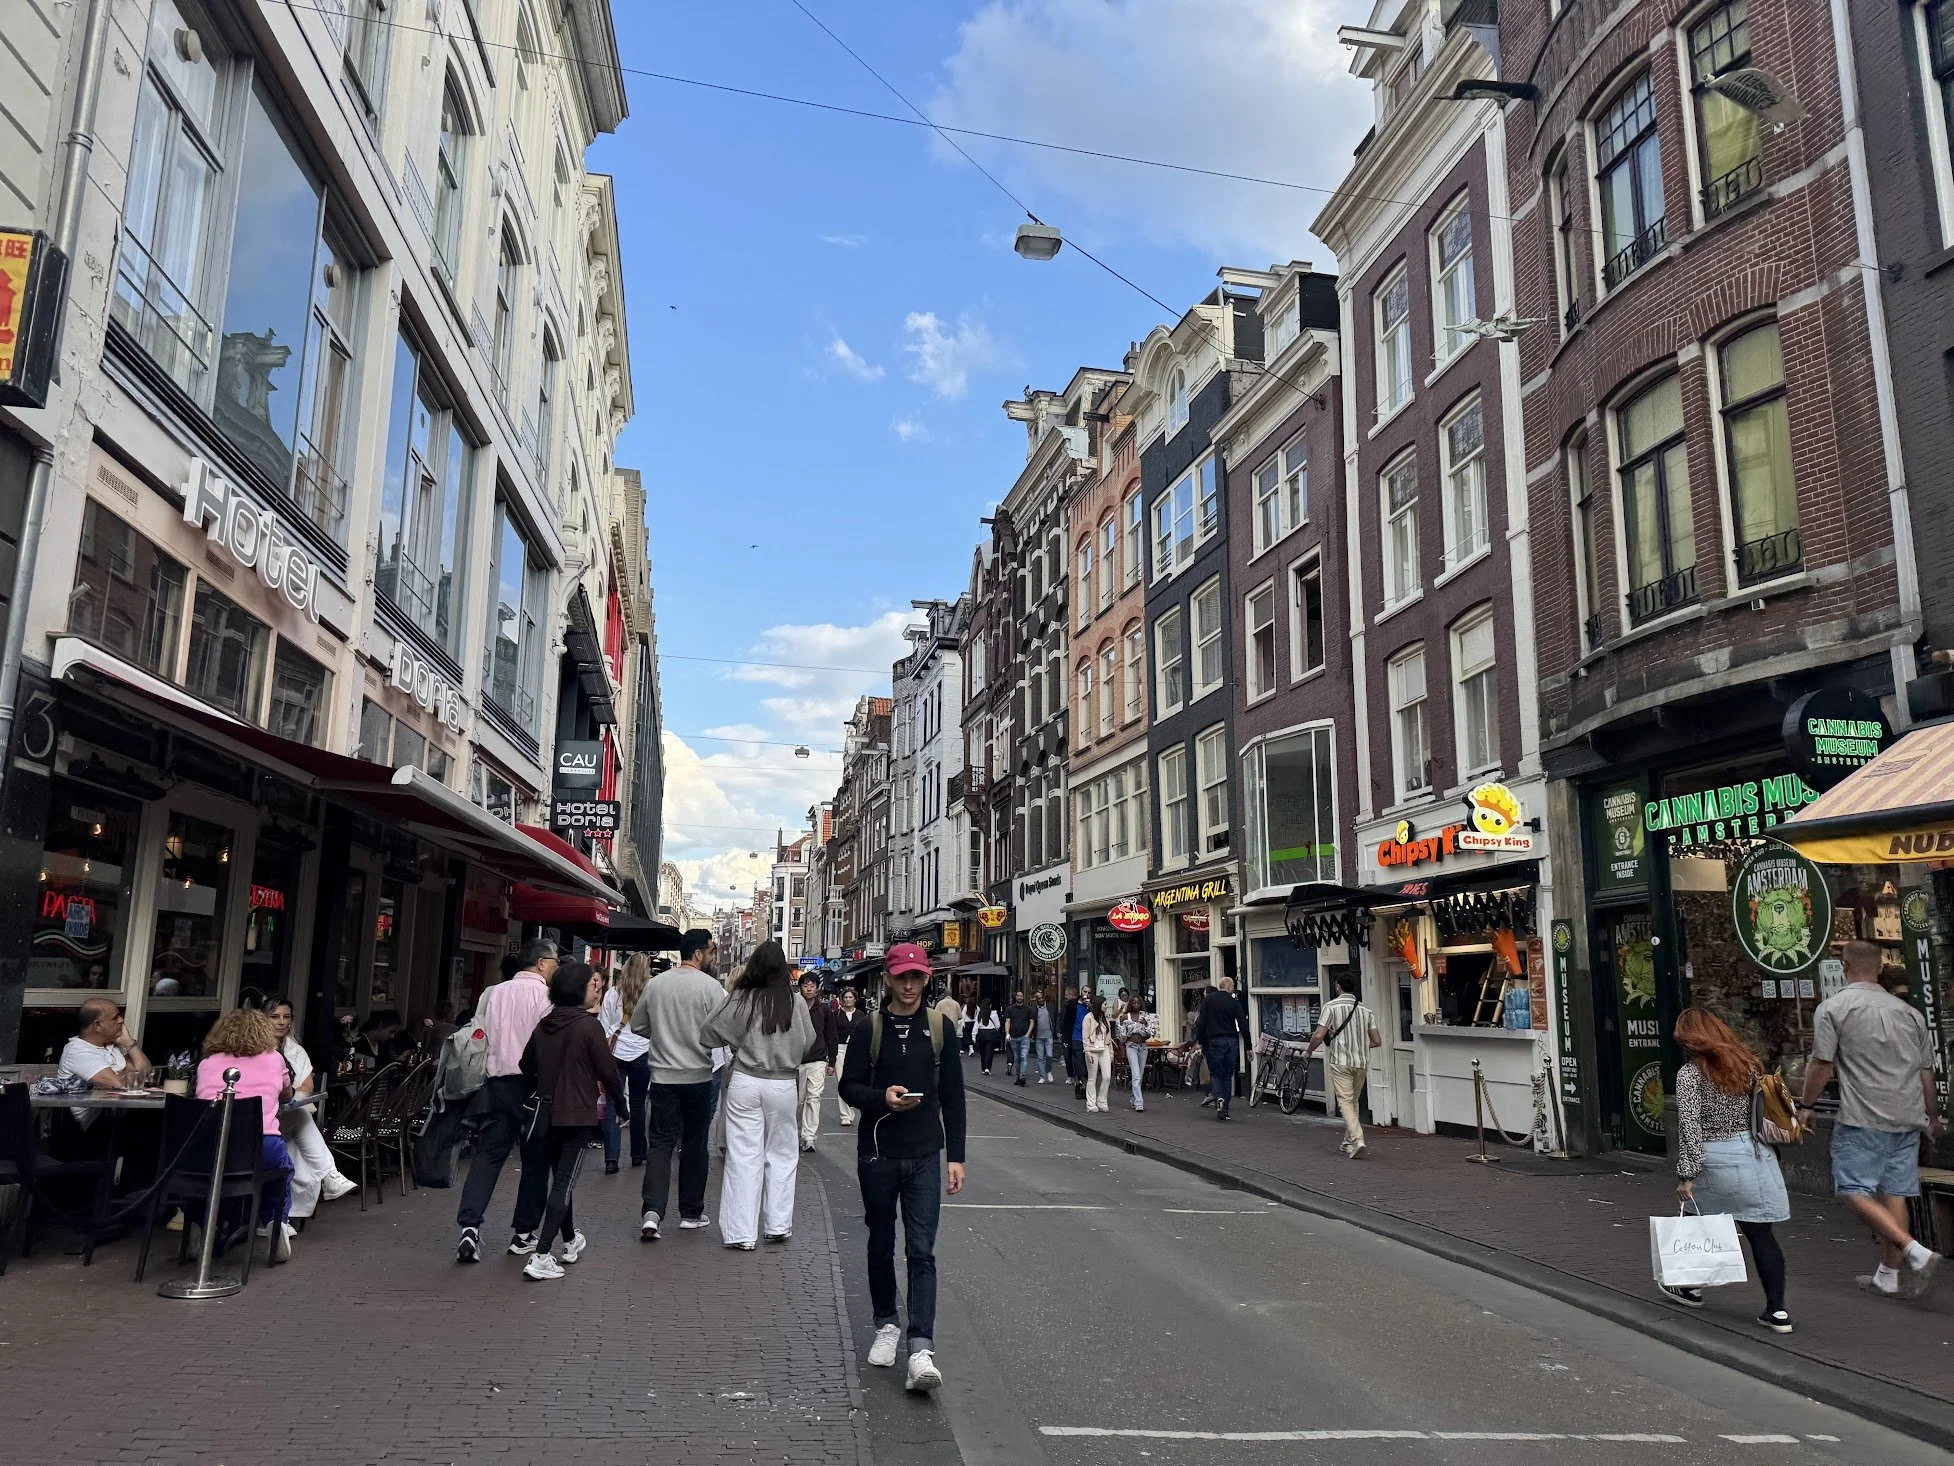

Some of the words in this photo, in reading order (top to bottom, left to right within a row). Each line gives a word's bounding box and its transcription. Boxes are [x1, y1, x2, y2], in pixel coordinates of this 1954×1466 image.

[183, 456, 321, 625] Hotel
[391, 641, 461, 734] Doria
[22, 690, 57, 759] 3
[1807, 718, 1883, 738] CANNABIS
[1815, 737, 1879, 757] MUSEUM
[560, 753, 597, 768] CAU
[1603, 792, 1636, 809] CANNABIS
[1644, 782, 1760, 832] CANNABIS
[1606, 803, 1636, 819] MUSEUM
[1462, 835, 1503, 848] Chipsy
[1504, 837, 1530, 848] King
[1378, 837, 1438, 868] Chipsy
[1611, 860, 1639, 872] ENTRANCE
[1616, 869, 1635, 879] INSIDE
[1747, 867, 1809, 897] AMSTERDAM
[1154, 884, 1200, 909] ARGENTINA
[1201, 879, 1227, 902] GRILL
[1560, 957, 1572, 1052] MUSEUM
[1561, 1057, 1578, 1067] OPEN
[1673, 1239, 1703, 1254] Cotton
